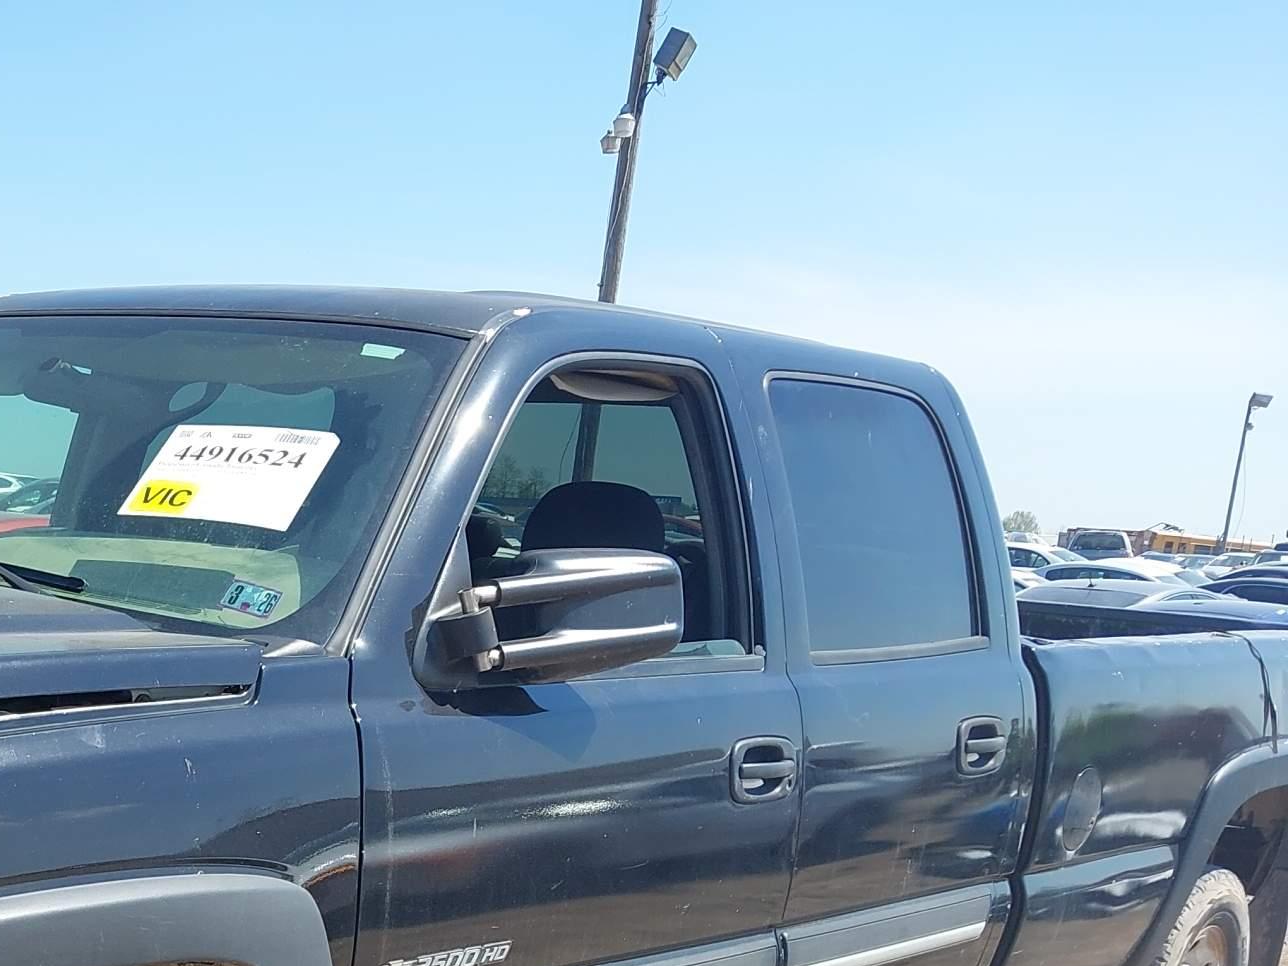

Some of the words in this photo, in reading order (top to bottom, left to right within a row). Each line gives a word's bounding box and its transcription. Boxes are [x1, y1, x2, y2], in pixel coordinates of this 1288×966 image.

[174, 444, 307, 469] 44916524
[142, 486, 193, 507] VIC
[228, 585, 244, 605] 3
[257, 592, 278, 614] 26
[480, 944, 511, 963] HD
